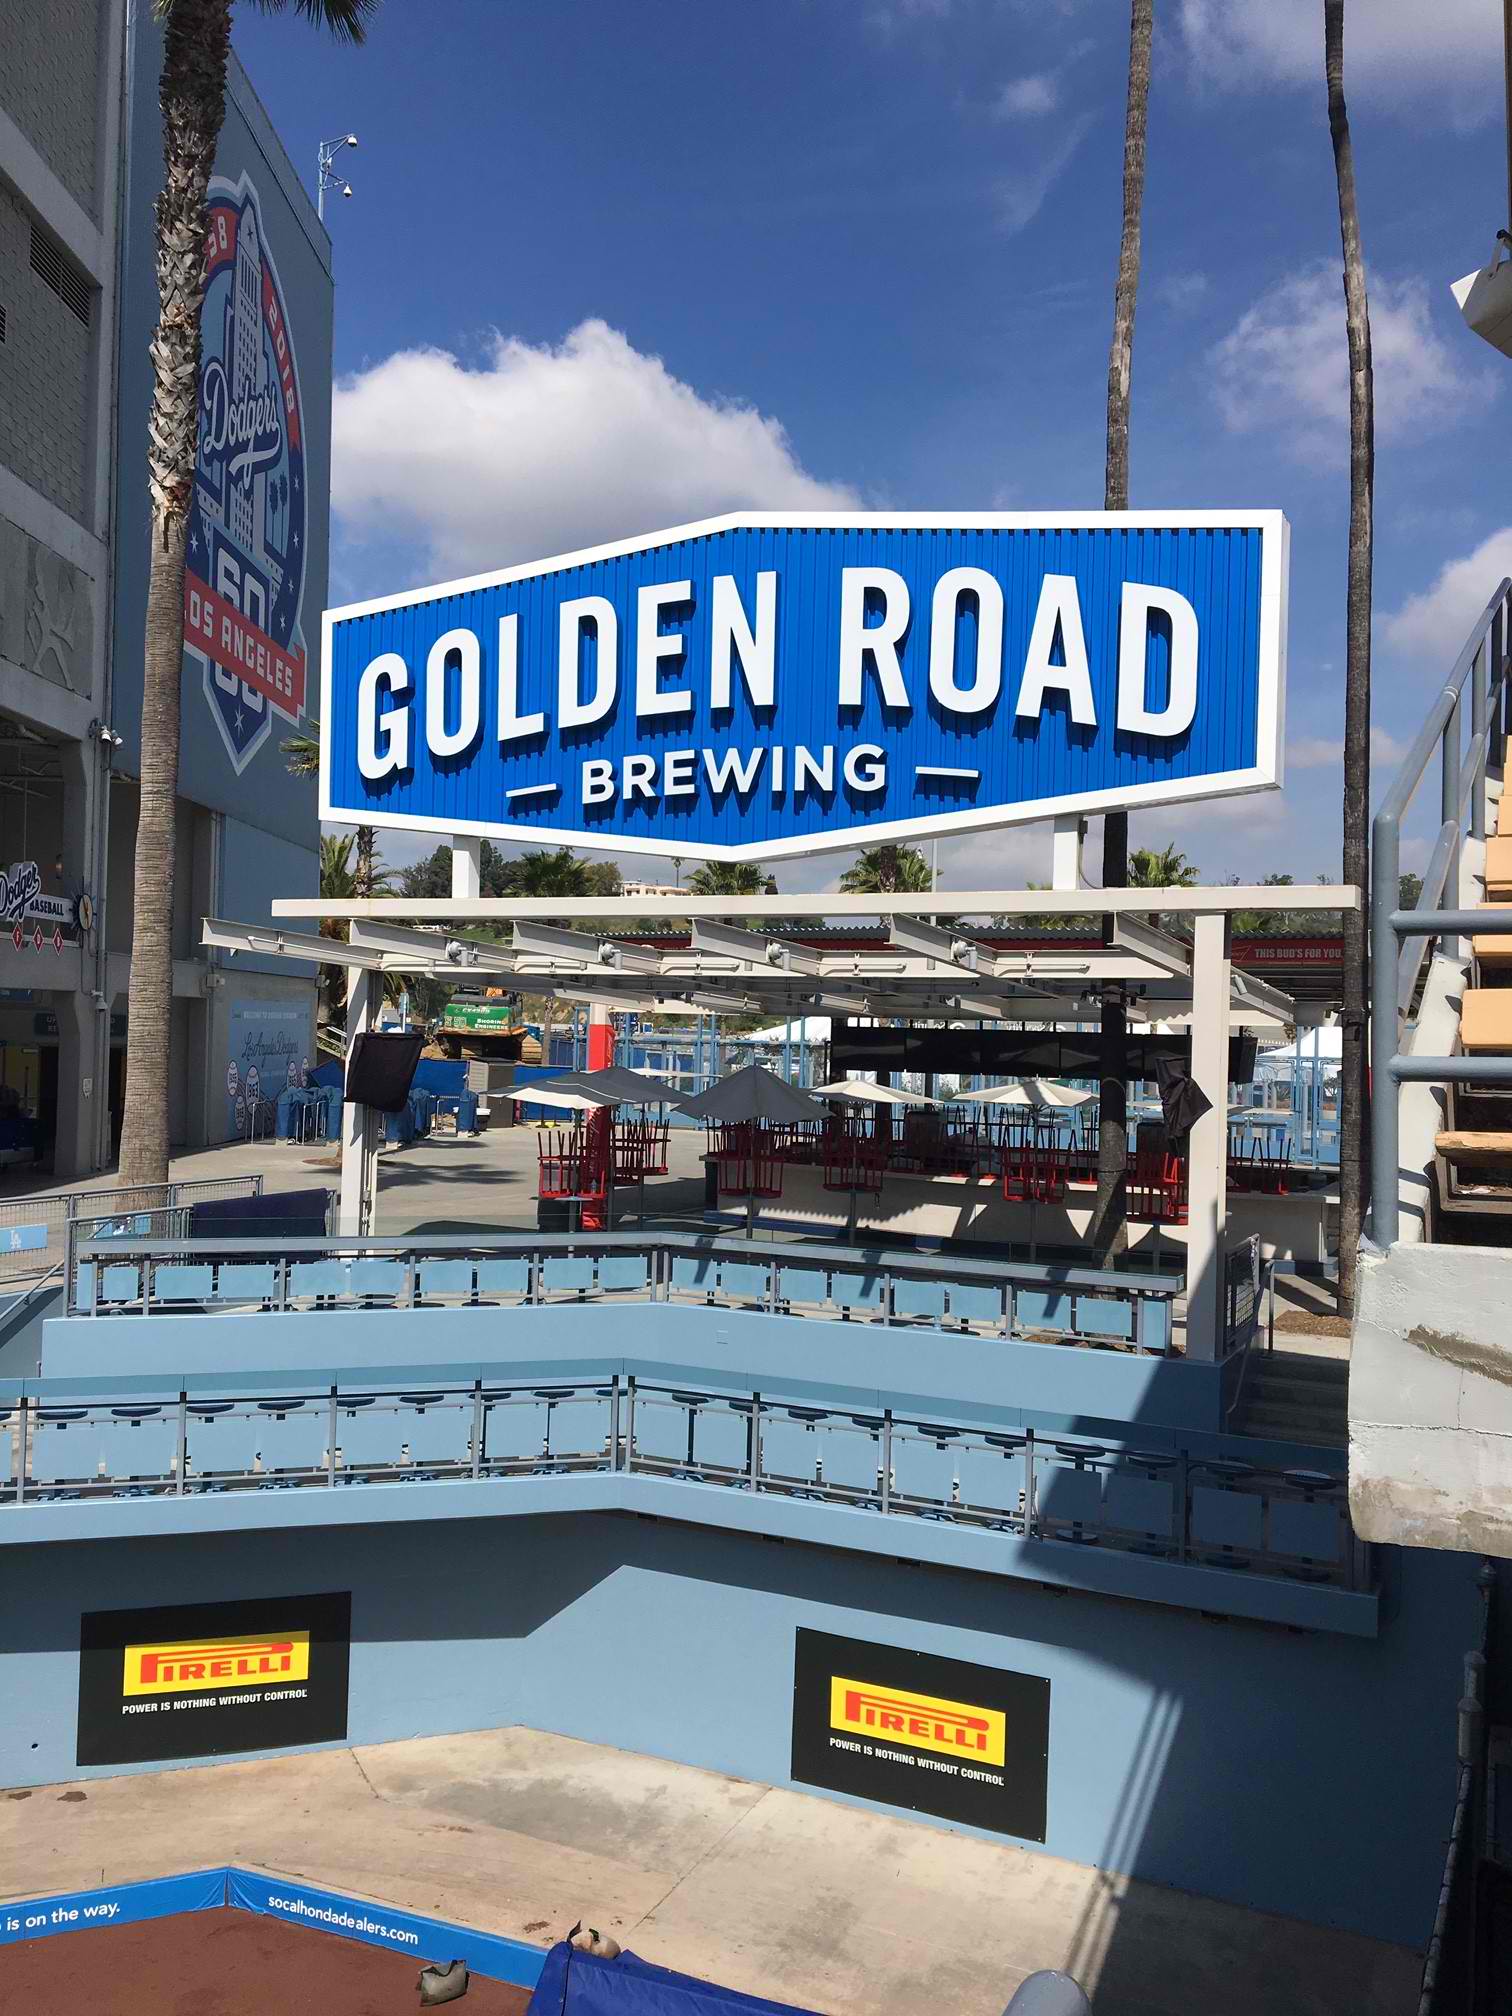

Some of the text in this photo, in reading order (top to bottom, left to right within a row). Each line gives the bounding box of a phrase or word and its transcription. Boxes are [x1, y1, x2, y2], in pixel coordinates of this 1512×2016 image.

[268, 296, 294, 413] 2018
[203, 362, 280, 489] Dodgers
[184, 590, 293, 697] OS ANGELES
[357, 567, 1199, 779] GOLDEN ROAD
[582, 744, 887, 805] BREWING
[30, 901, 64, 916] BASEBALL
[1255, 948, 1275, 958] THIS
[1277, 948, 1304, 958] BUD'S
[1305, 948, 1321, 958] FOR
[140, 1641, 294, 1684] PIRELLI
[122, 1703, 158, 1714] POWER
[160, 1702, 171, 1711] IS
[173, 1697, 216, 1710] NOTHING
[219, 1693, 262, 1706] WITHOUT
[845, 1690, 990, 1751] PIRELLI
[830, 1737, 861, 1753] POWER
[863, 1745, 872, 1756] IS
[875, 1748, 915, 1766] NOTHING
[917, 1757, 958, 1776] WITHOUT
[7, 1903, 120, 1931] is on the way.
[268, 1896, 419, 1945] socalhondadealers.com
